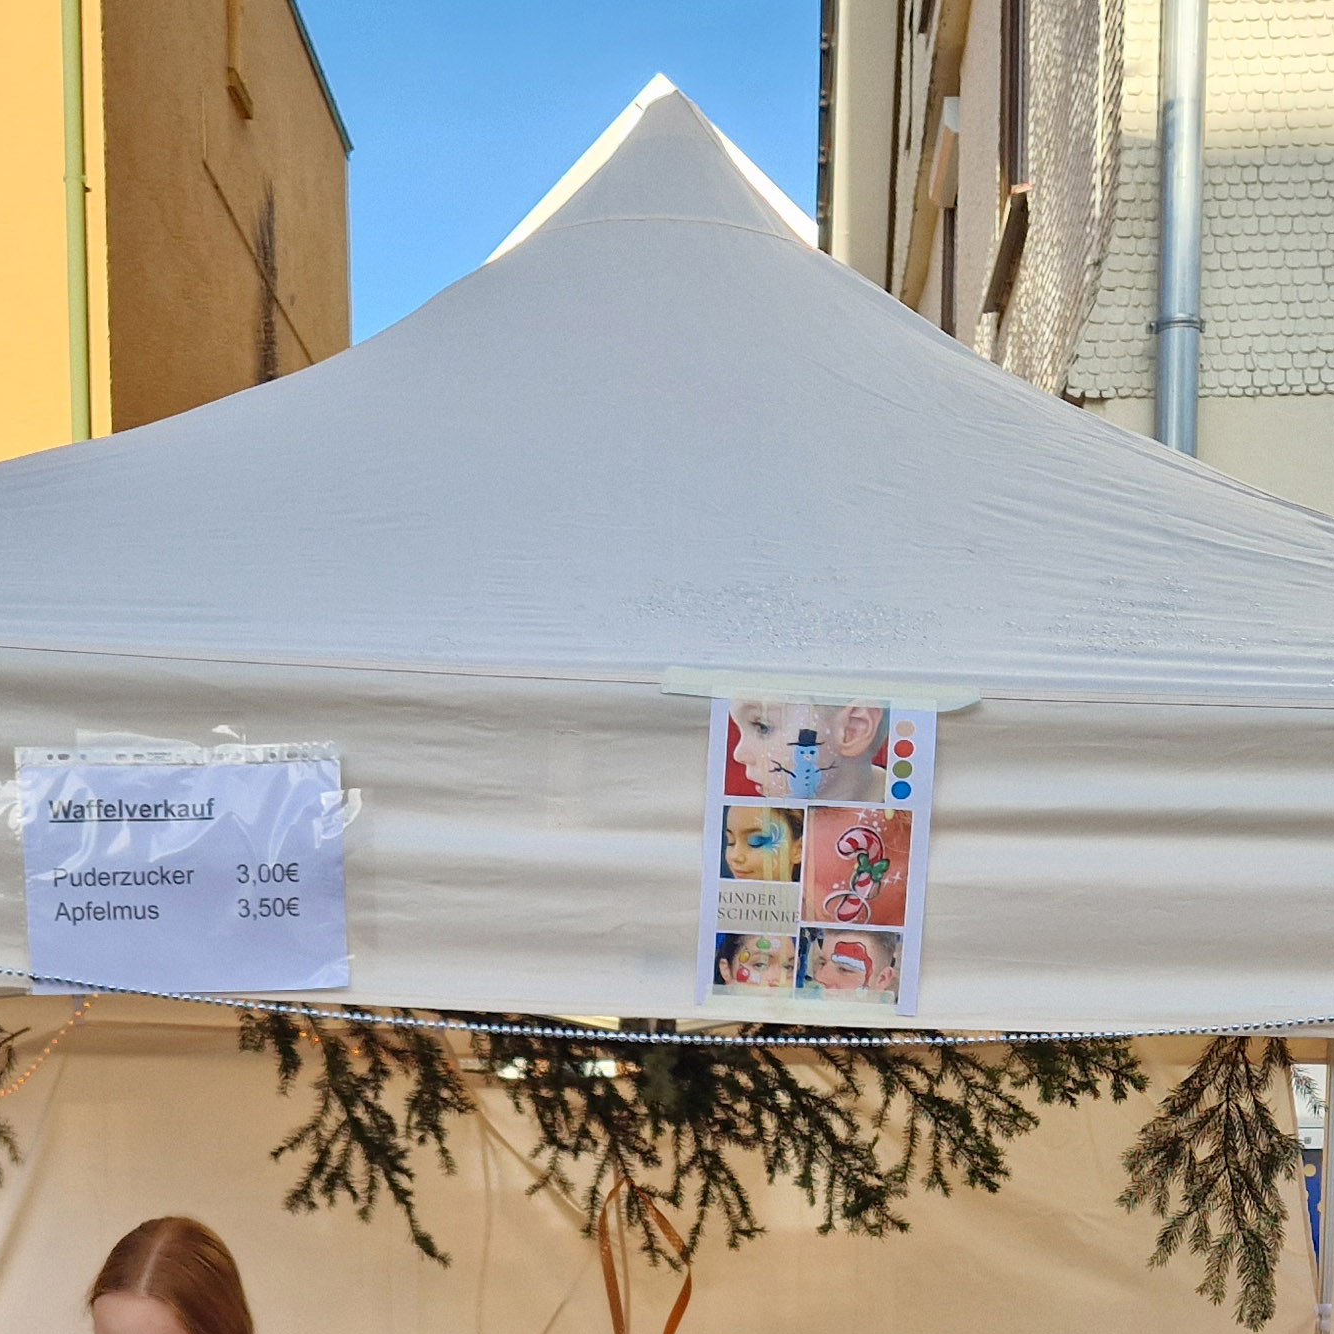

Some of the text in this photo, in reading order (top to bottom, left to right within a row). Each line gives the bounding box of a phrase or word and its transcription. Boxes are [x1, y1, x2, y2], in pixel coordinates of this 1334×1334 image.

[49, 797, 215, 821] Waffelverkauf
[53, 863, 301, 889] Puderzucker 3,00€
[54, 897, 301, 925] Apfelmus 3,50€
[717, 907, 800, 923] SCHMINKE
